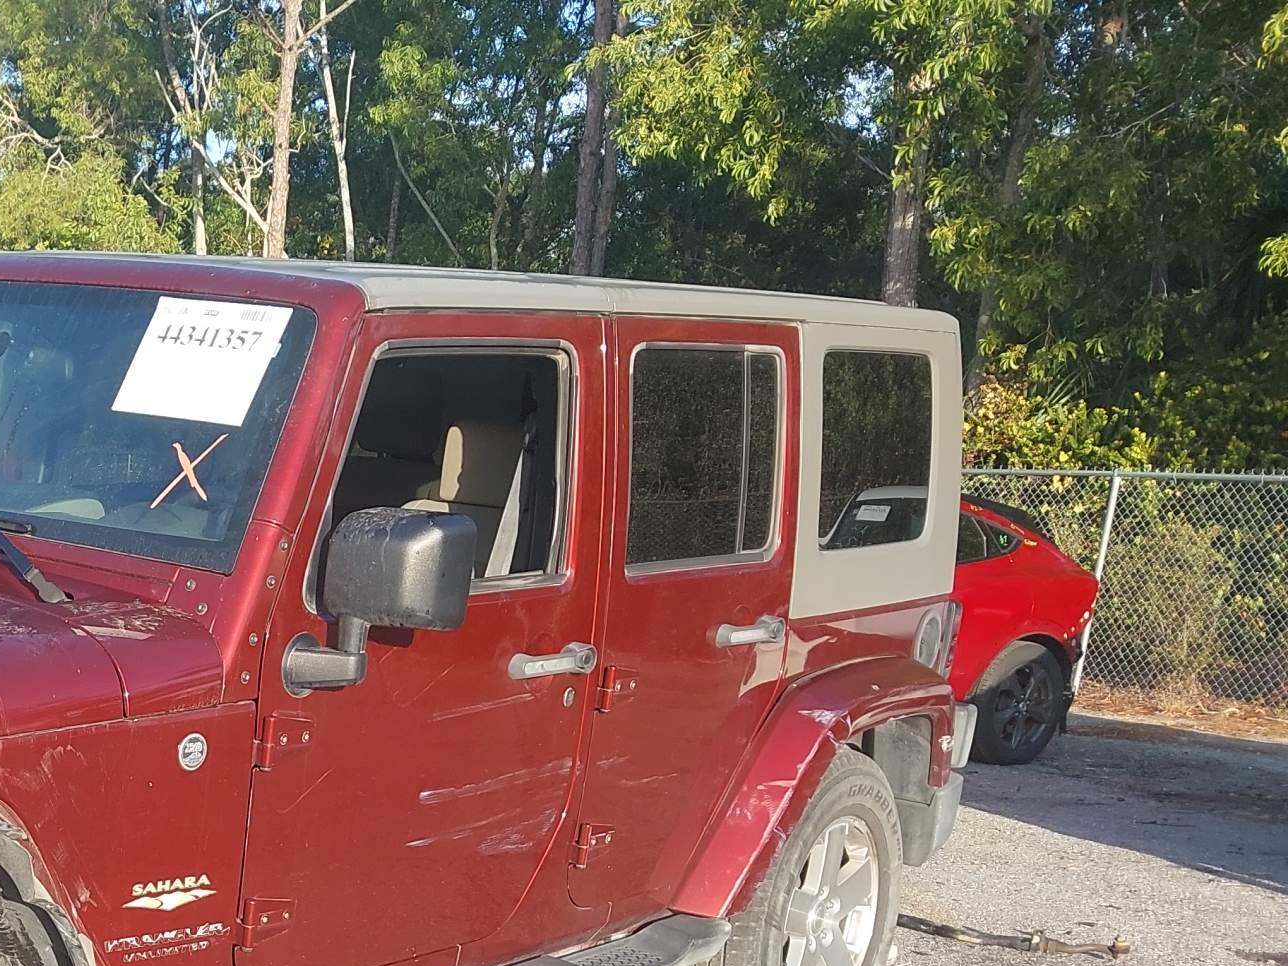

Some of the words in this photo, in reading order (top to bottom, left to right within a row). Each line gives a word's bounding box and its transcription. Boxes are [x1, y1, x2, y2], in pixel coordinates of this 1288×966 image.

[157, 324, 264, 351] 44341357
[132, 874, 211, 896] SAHARA
[104, 922, 231, 953] WRANGLER
[122, 940, 210, 963] UNLIMITED
